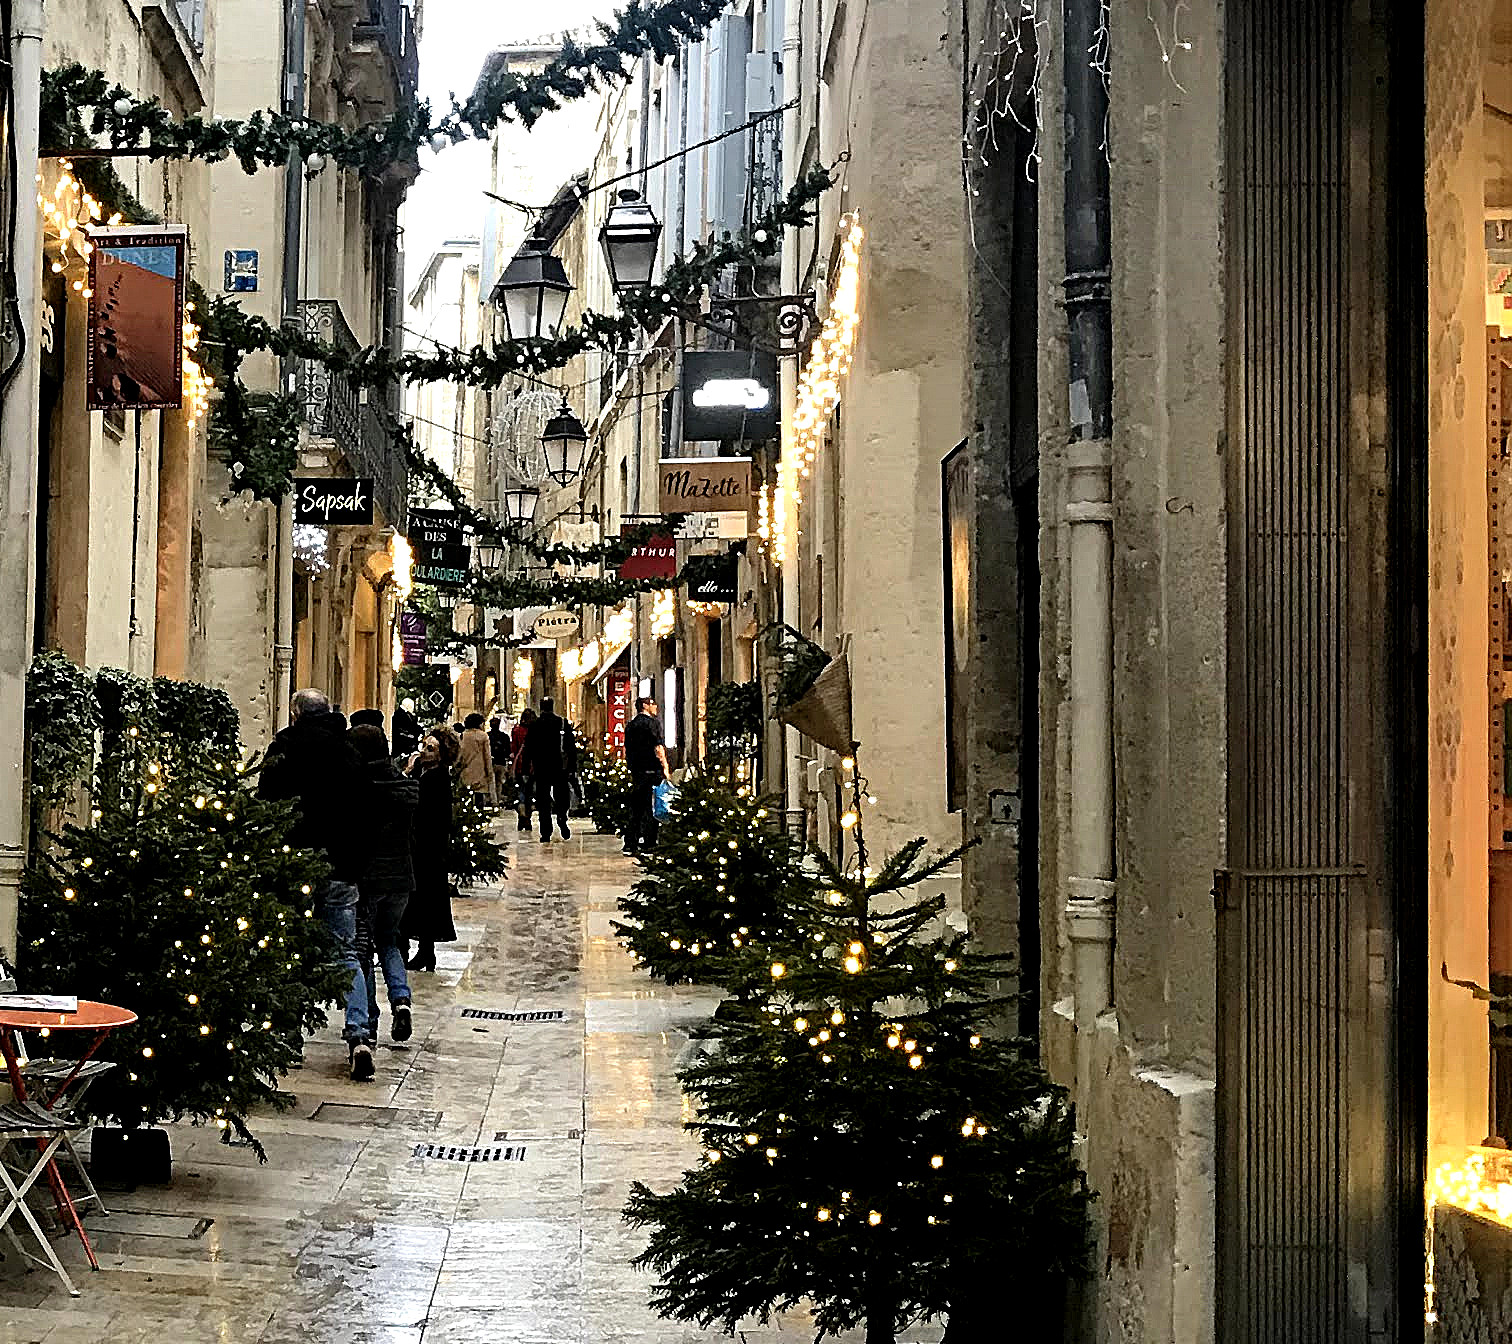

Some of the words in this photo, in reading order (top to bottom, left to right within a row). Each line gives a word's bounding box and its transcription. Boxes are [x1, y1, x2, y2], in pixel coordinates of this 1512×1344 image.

[129, 236, 181, 245] Tradition
[301, 481, 367, 521] Sapsak
[424, 531, 447, 542] DES
[431, 546, 443, 561] LA
[631, 547, 675, 557] RTHUR
[408, 564, 466, 584] OULARDIERE
